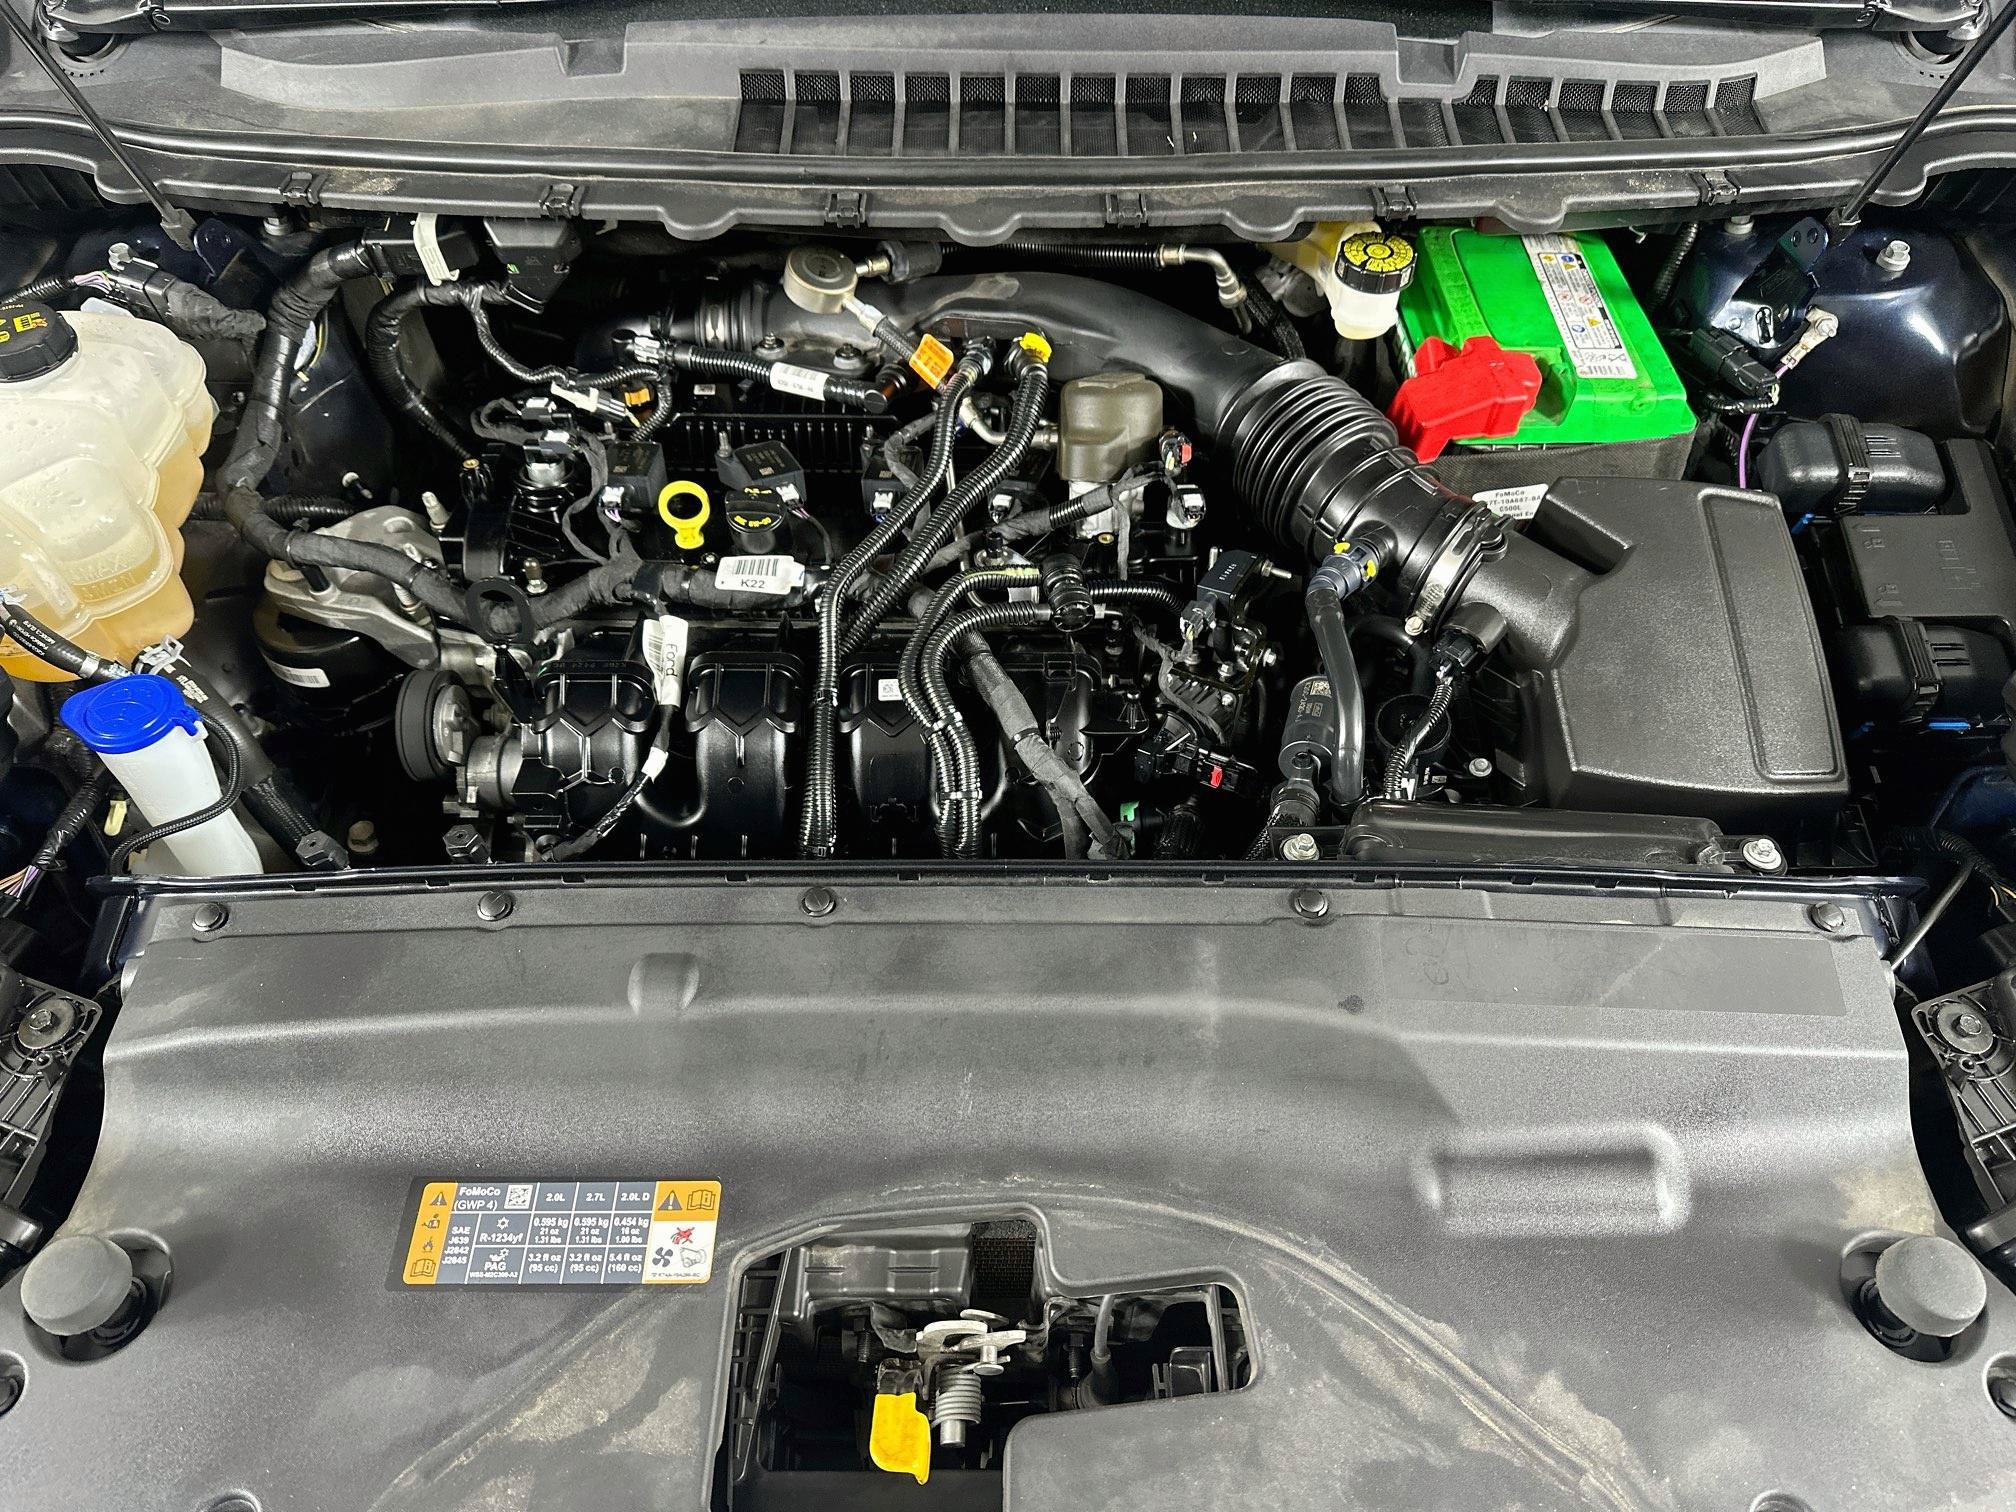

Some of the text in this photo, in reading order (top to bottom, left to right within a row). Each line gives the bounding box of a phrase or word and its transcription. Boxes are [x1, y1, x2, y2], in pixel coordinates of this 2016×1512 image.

[740, 578, 765, 589] K22
[665, 643, 678, 677] Ford
[458, 1186, 501, 1196] FoMoCo
[545, 1193, 566, 1202] 2.0L
[585, 1193, 605, 1202] 2.7L
[620, 1192, 650, 1201] 2.0L D
[453, 1200, 498, 1212] (GWP 4)
[533, 1217, 569, 1228] 0.595 kg
[574, 1217, 609, 1228] 0.595 kg
[614, 1217, 649, 1228] 0.454 kg
[451, 1226, 471, 1235] SAE
[448, 1236, 470, 1245] J639
[479, 1232, 524, 1244] R-1234yf
[528, 1254, 562, 1262] 3.2 fl oz
[569, 1253, 602, 1262] 3.2 fl oz
[609, 1253, 643, 1262] 5.4 fl oz
[484, 1261, 506, 1271] PAG
[528, 1264, 558, 1274] (95 cc)
[570, 1264, 600, 1274] (95 cc)
[628, 1264, 642, 1274] cc)
